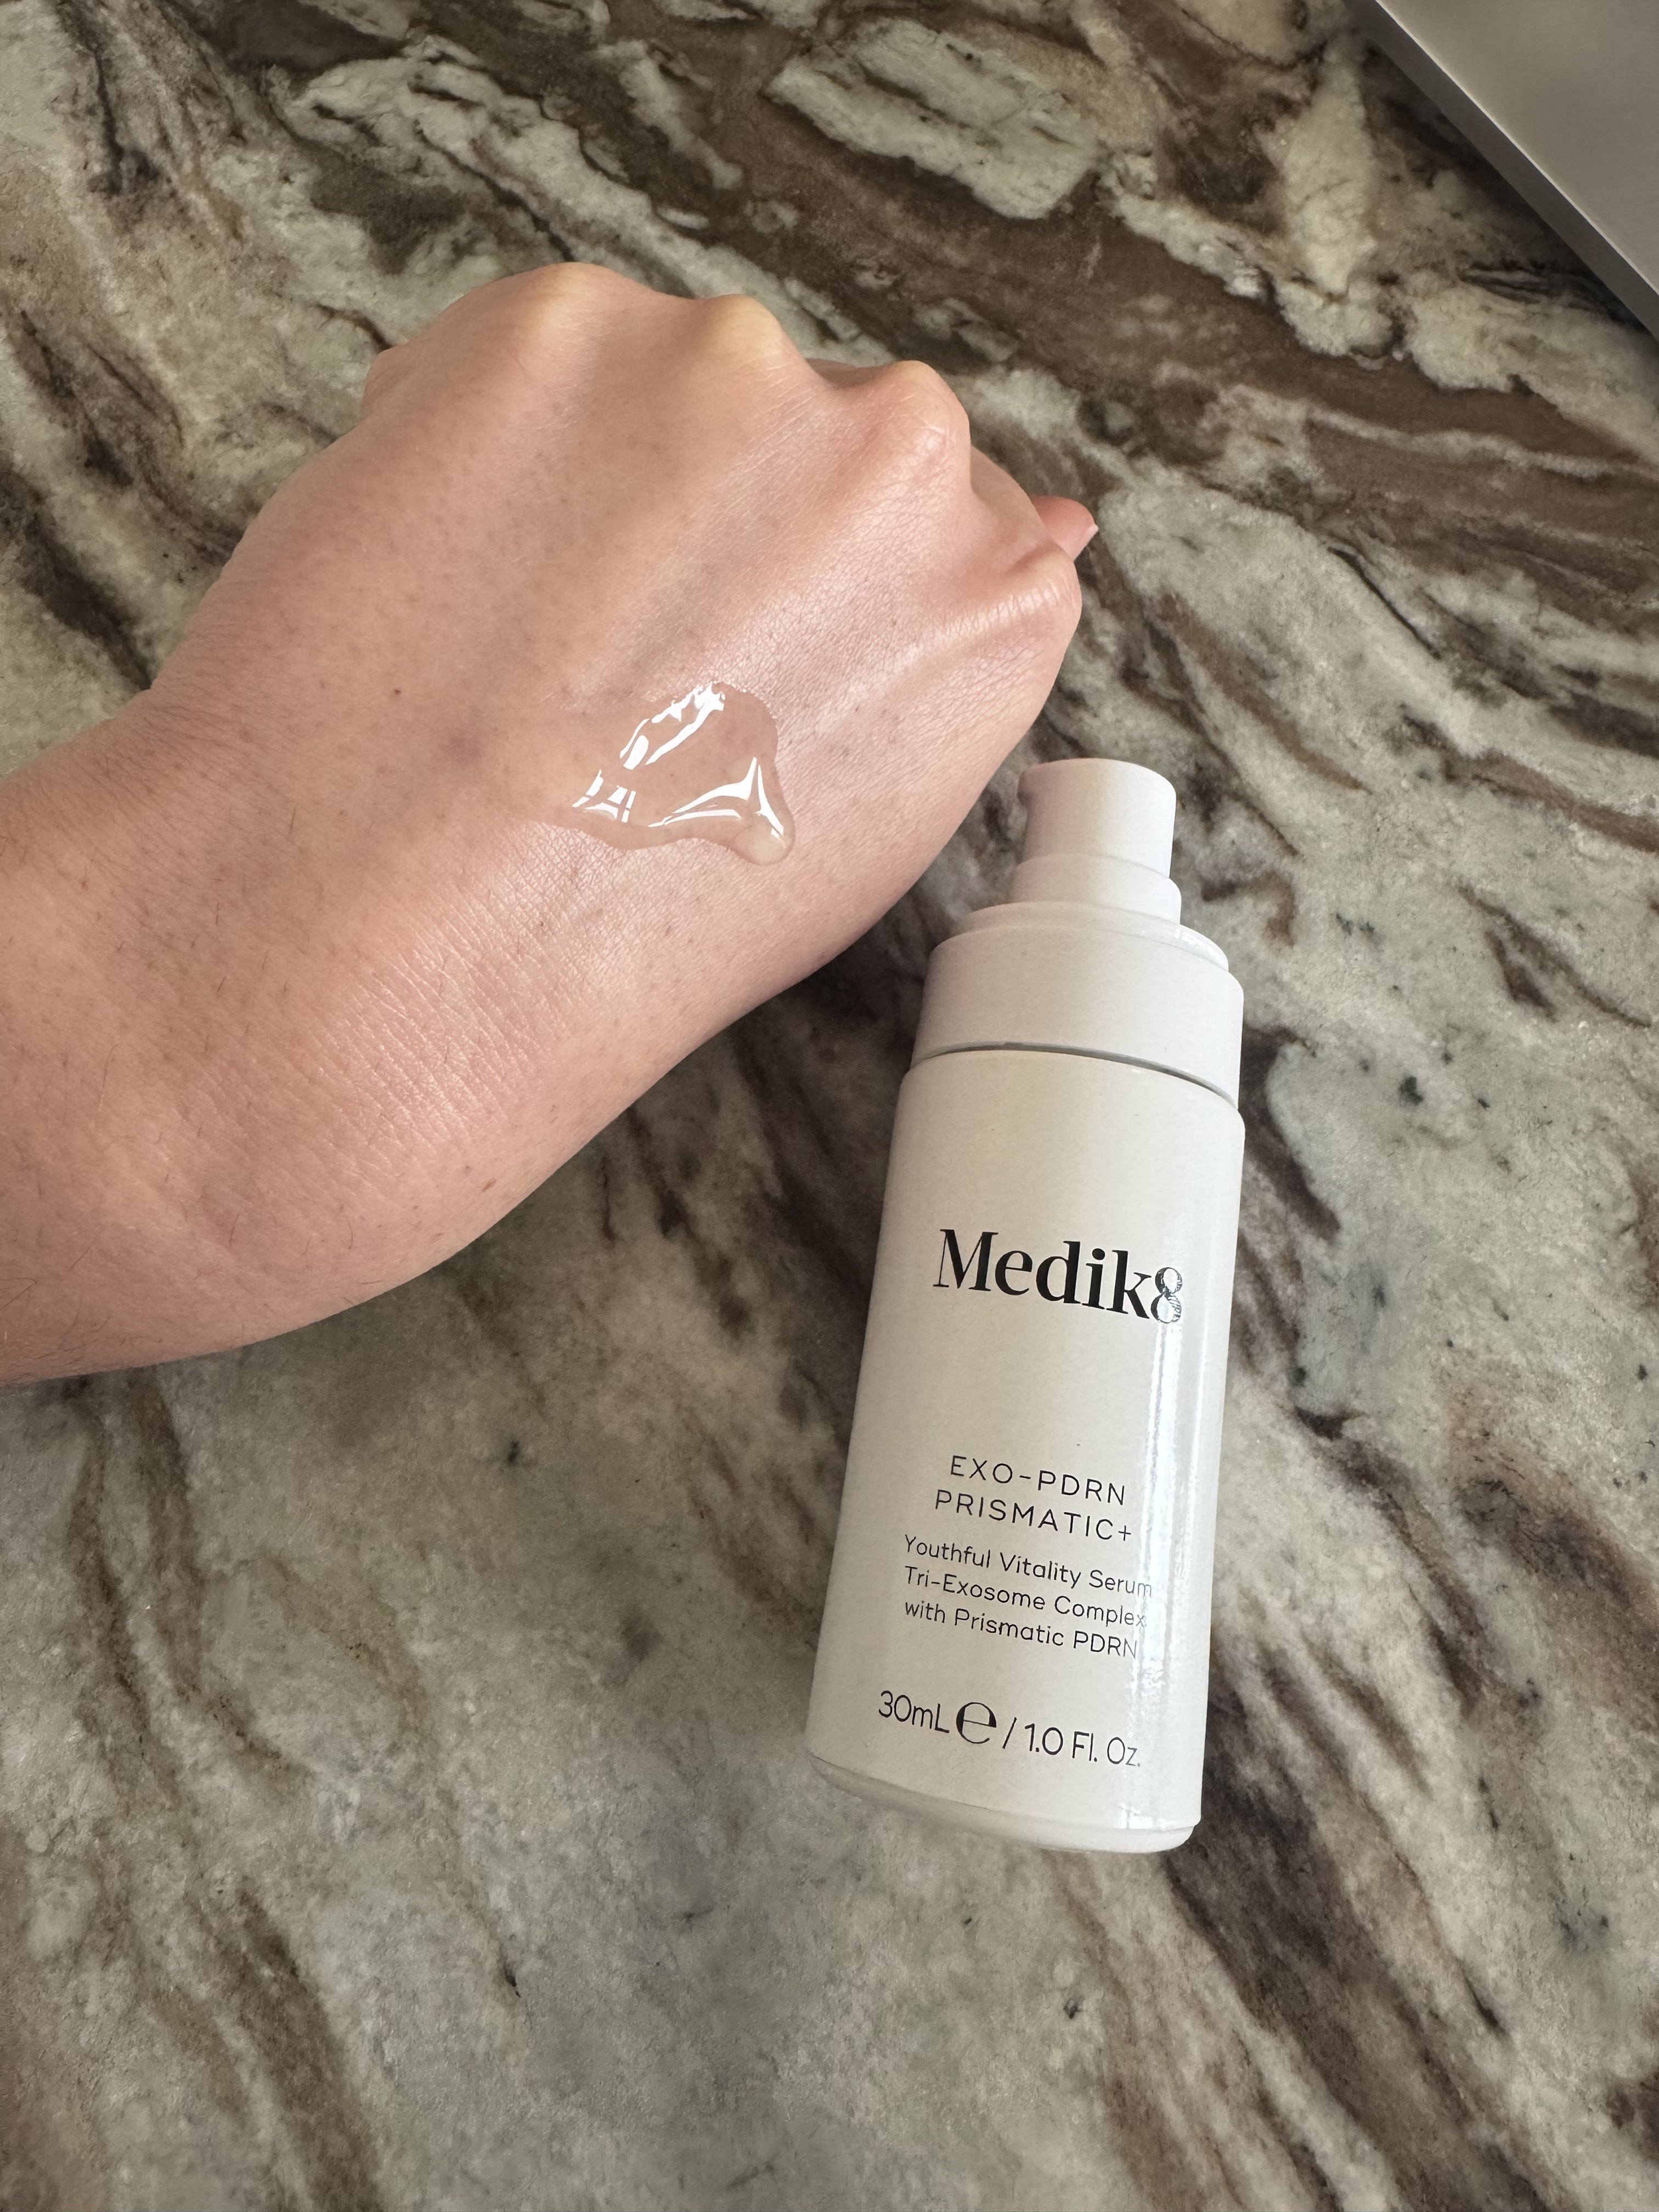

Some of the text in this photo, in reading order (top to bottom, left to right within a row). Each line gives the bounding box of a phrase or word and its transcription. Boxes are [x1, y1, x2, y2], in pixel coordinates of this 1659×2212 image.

[933, 1229, 1183, 1324] Medik8
[950, 1455, 1125, 1505] EXO-PDRN
[935, 1489, 1132, 1542] PRISMATIC+
[905, 1534, 1152, 1597] Youthful Vitality Serum
[905, 1565, 1147, 1628] Tri-Exosome Complex
[905, 1601, 1137, 1660] with Prismatic PDRN
[878, 1690, 950, 1734] 30mL
[1024, 1723, 1064, 1755] 1.0
[1071, 1731, 1098, 1763] Fl.
[1106, 1736, 1141, 1768] Oz.
